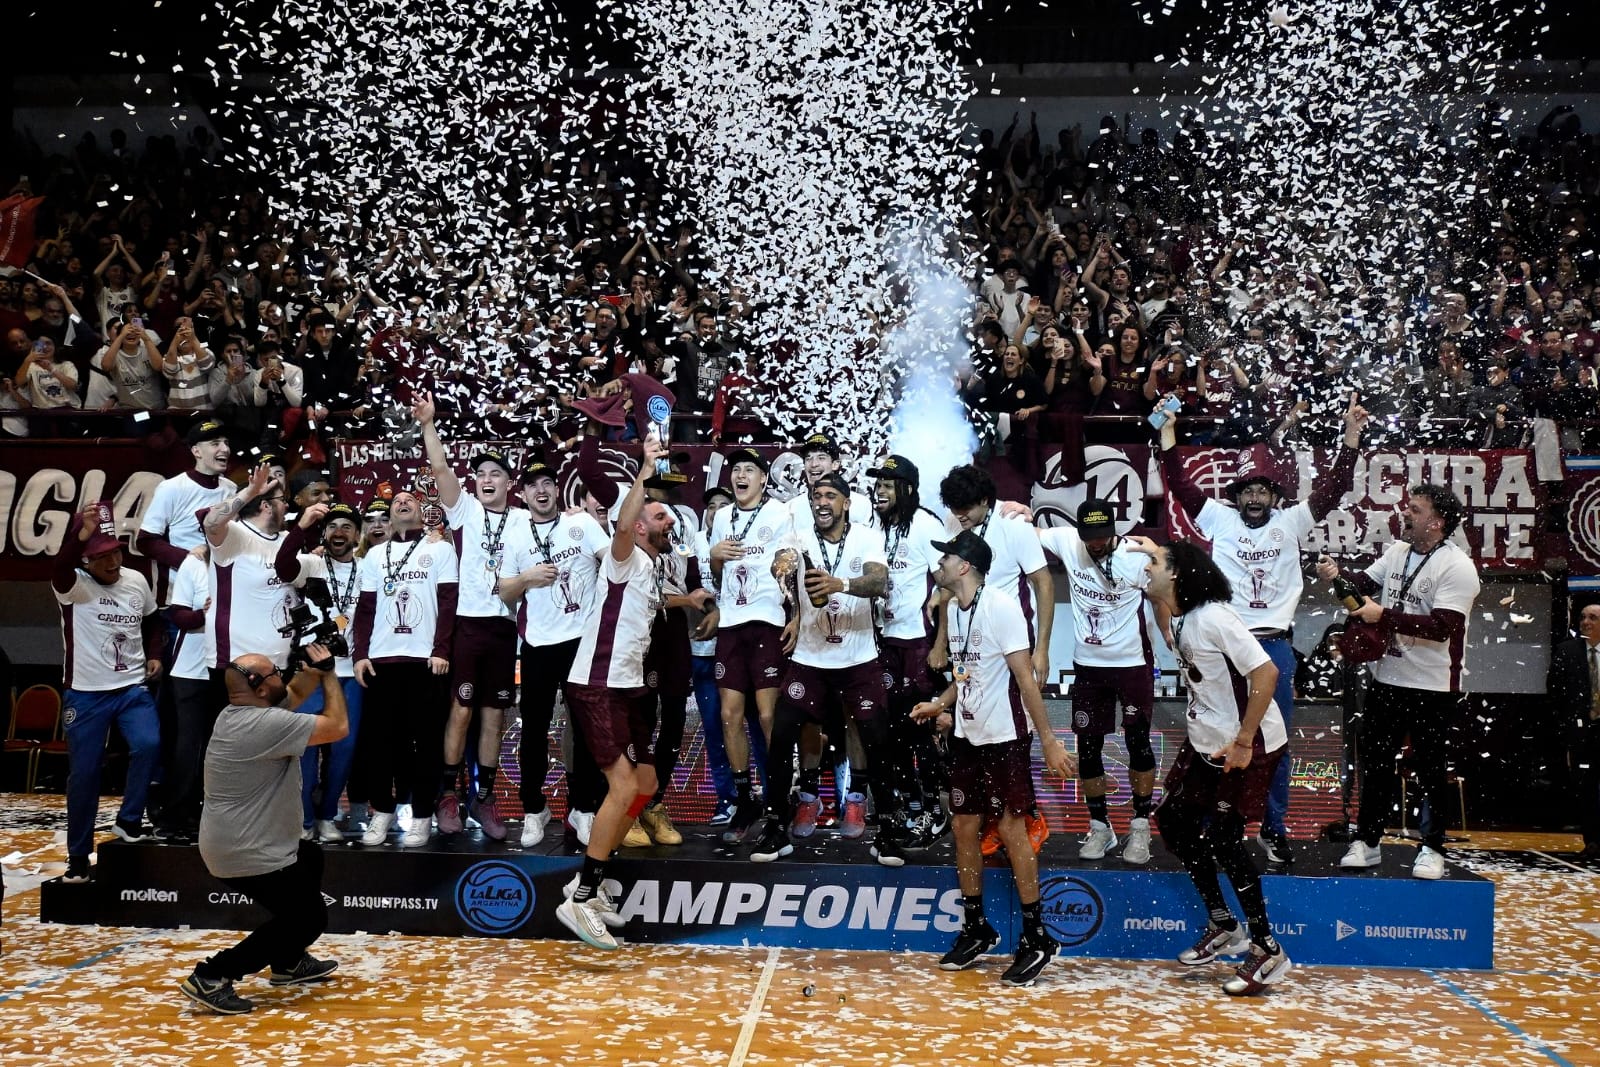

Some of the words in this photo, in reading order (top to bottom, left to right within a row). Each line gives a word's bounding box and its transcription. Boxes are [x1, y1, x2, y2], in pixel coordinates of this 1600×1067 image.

[340, 444, 370, 468] LAS
[121, 889, 178, 902] molten
[208, 892, 253, 905] CATA
[343, 895, 438, 911] BASQUETPASS.TV
[1124, 917, 1186, 931] molten
[1364, 925, 1467, 941] BASQUETPASS.TV
